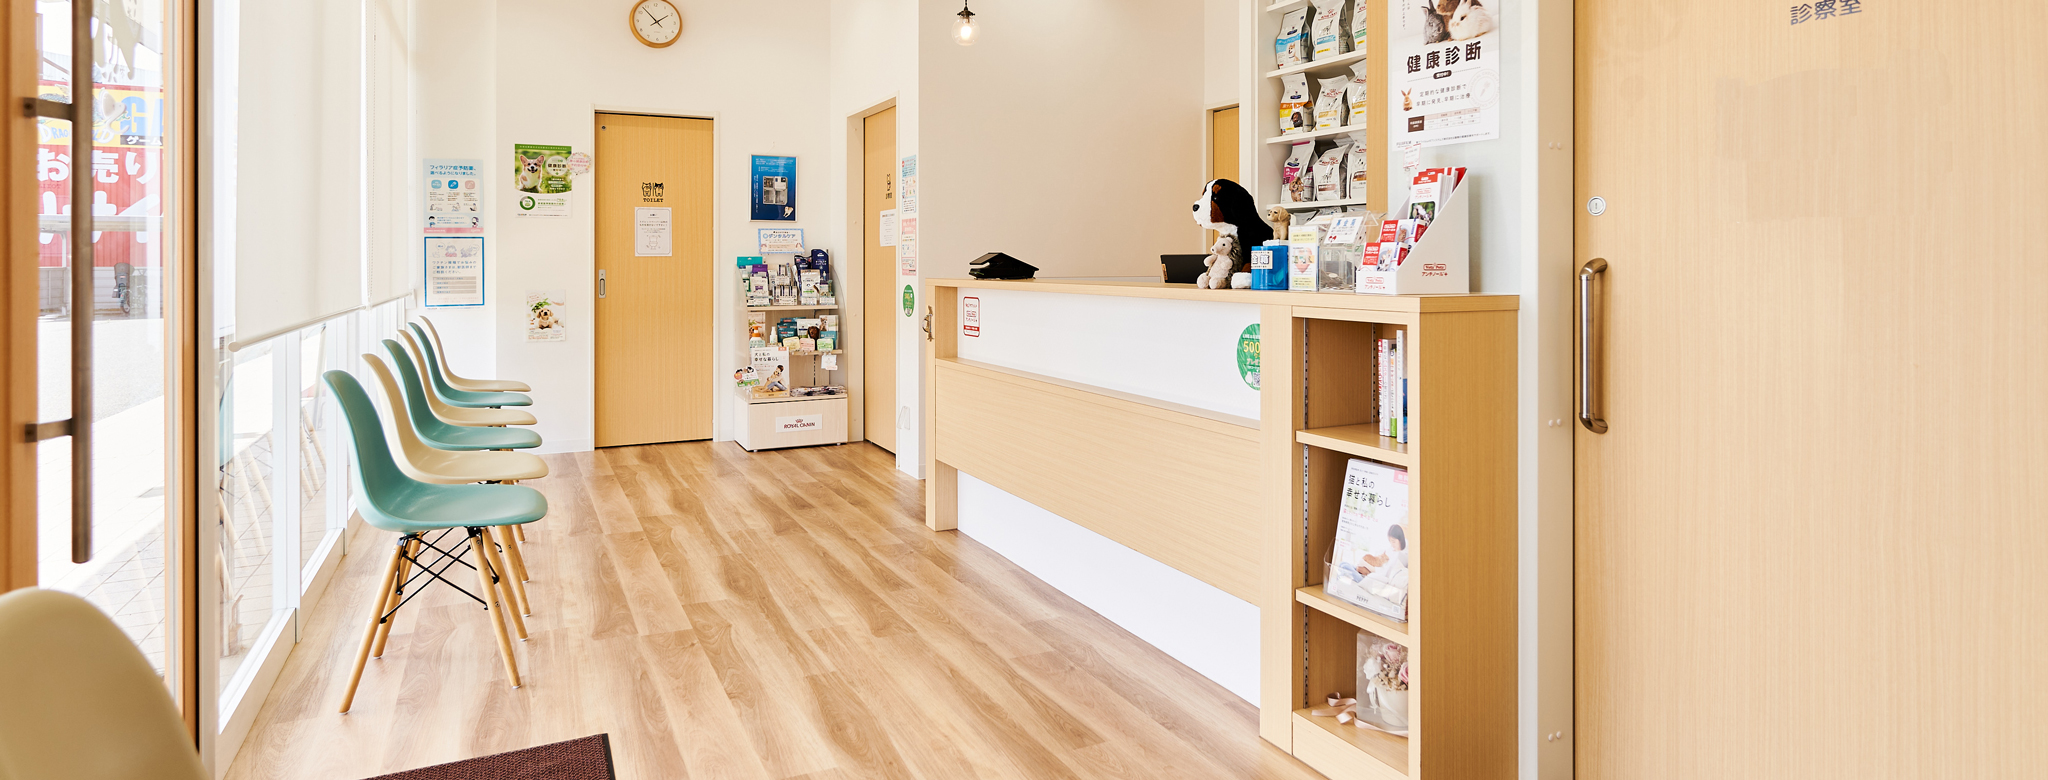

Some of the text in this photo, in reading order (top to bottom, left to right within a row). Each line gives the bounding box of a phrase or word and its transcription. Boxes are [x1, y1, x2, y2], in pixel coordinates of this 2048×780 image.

[1790, 0, 1862, 25] 診察室
[1407, 41, 1481, 74] 健康診断
[38, 123, 72, 143] DRAG
[1251, 254, 1270, 265] 金箱
[1243, 340, 1261, 353] 500
